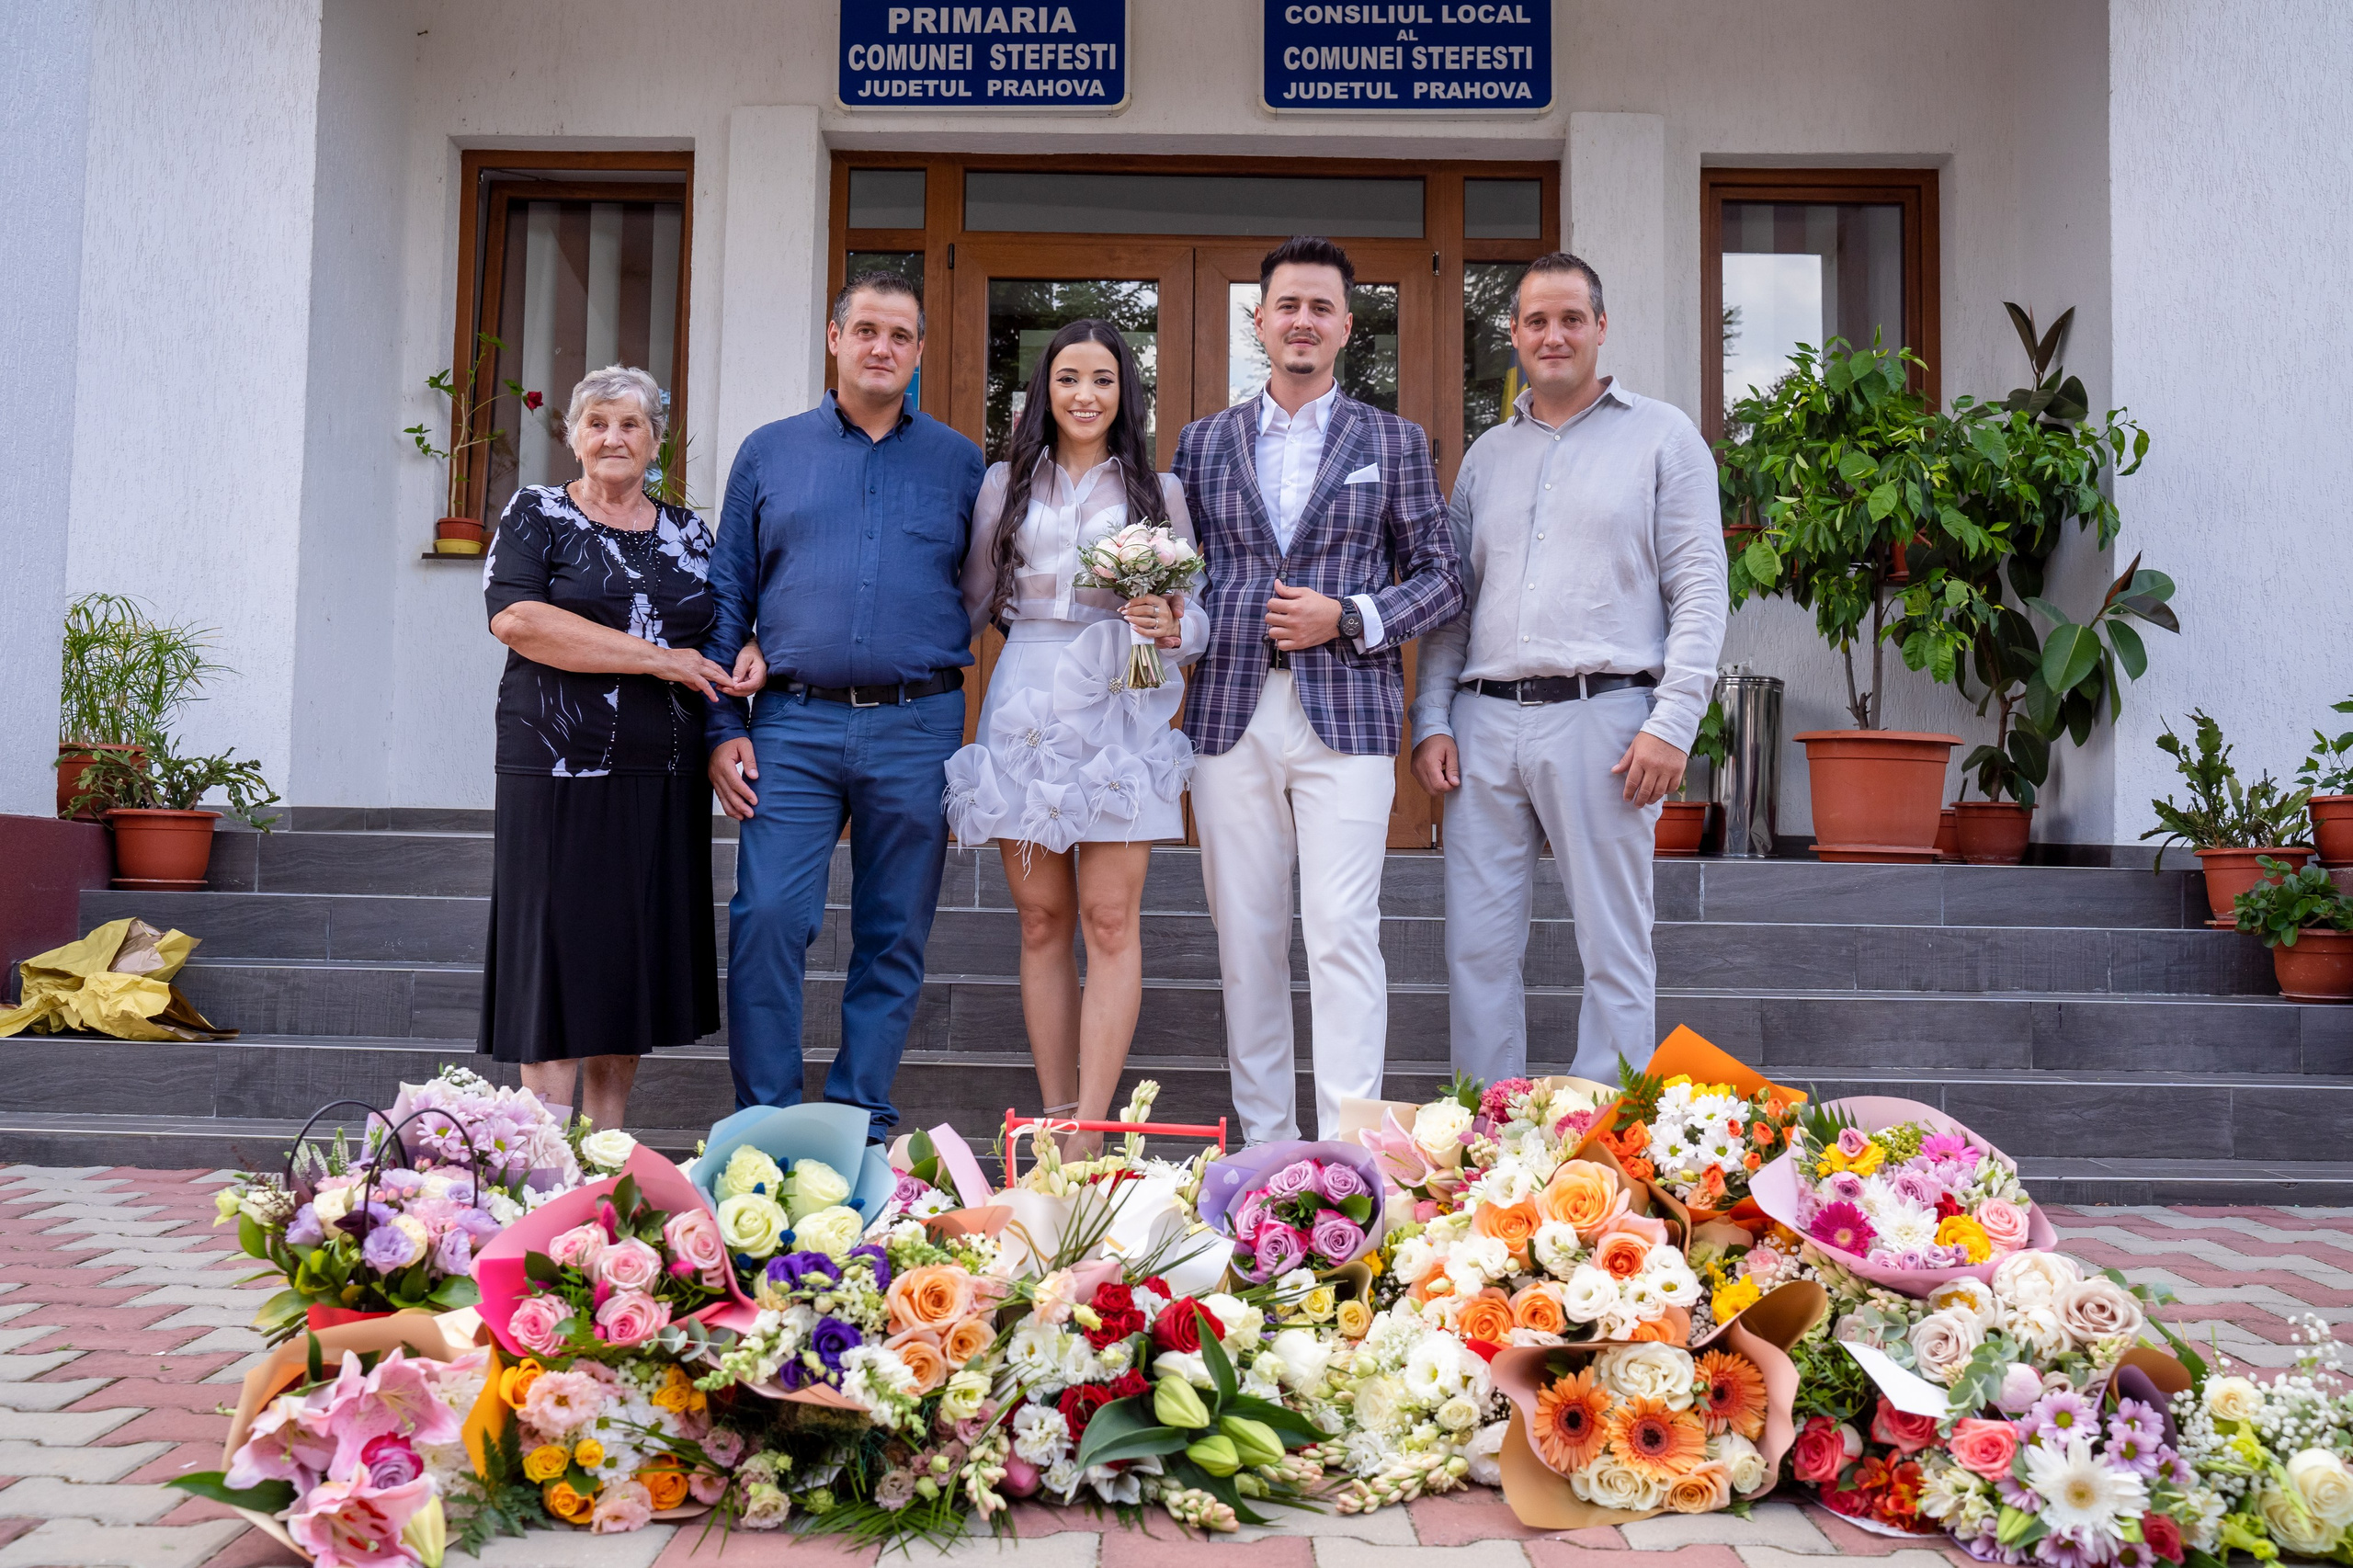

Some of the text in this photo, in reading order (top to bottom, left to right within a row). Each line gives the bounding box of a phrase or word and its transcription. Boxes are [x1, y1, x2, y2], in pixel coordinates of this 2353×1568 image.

[888, 7, 1076, 34] PRIMARIA
[1284, 5, 1531, 24] CONSILIUL LOCAL
[1396, 29, 1418, 41] AL
[847, 43, 1117, 71] COMUNEI STEFESTI
[1283, 46, 1533, 71] COMUNEI STEFESTI
[858, 79, 1106, 97] JUDETUL PRAHOVA
[1282, 82, 1533, 99] JUDETUL PRAHOVA
